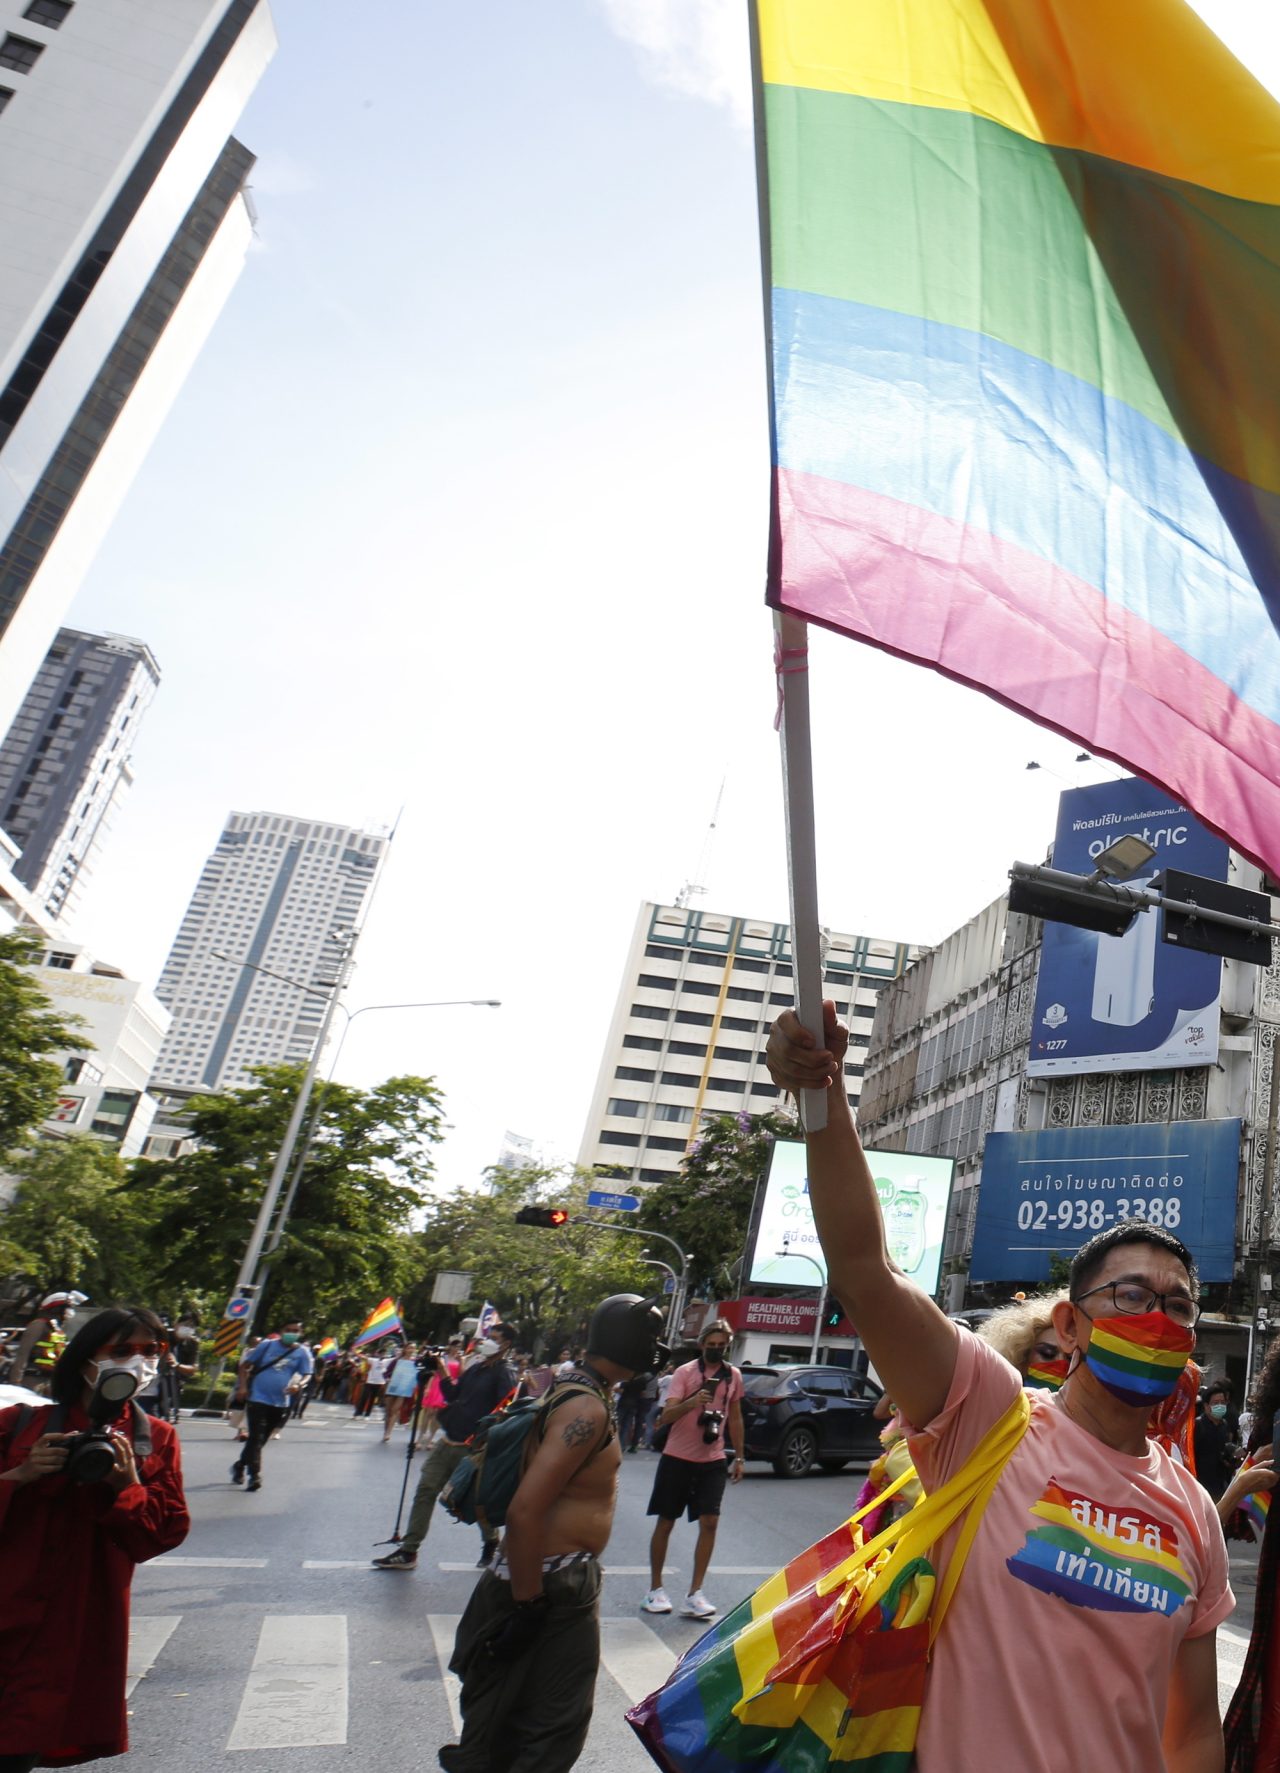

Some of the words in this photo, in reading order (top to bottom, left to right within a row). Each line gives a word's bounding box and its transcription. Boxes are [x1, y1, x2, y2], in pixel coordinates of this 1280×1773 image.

[1073, 813, 1122, 830] พัดลมไร้ใบ
[1088, 826, 1188, 858] altric
[1046, 1040, 1068, 1050] 1277
[1020, 1172, 1184, 1191] สนใจโฆษณาติดต่อ
[1017, 1197, 1181, 1231] 02-938-3388
[746, 1313, 777, 1324] BETTER
[777, 1315, 801, 1325] LIVES
[794, 1305, 820, 1316] LONGE
[1071, 1499, 1162, 1554] สมรส
[1055, 1546, 1169, 1611] เท่าเทียม
